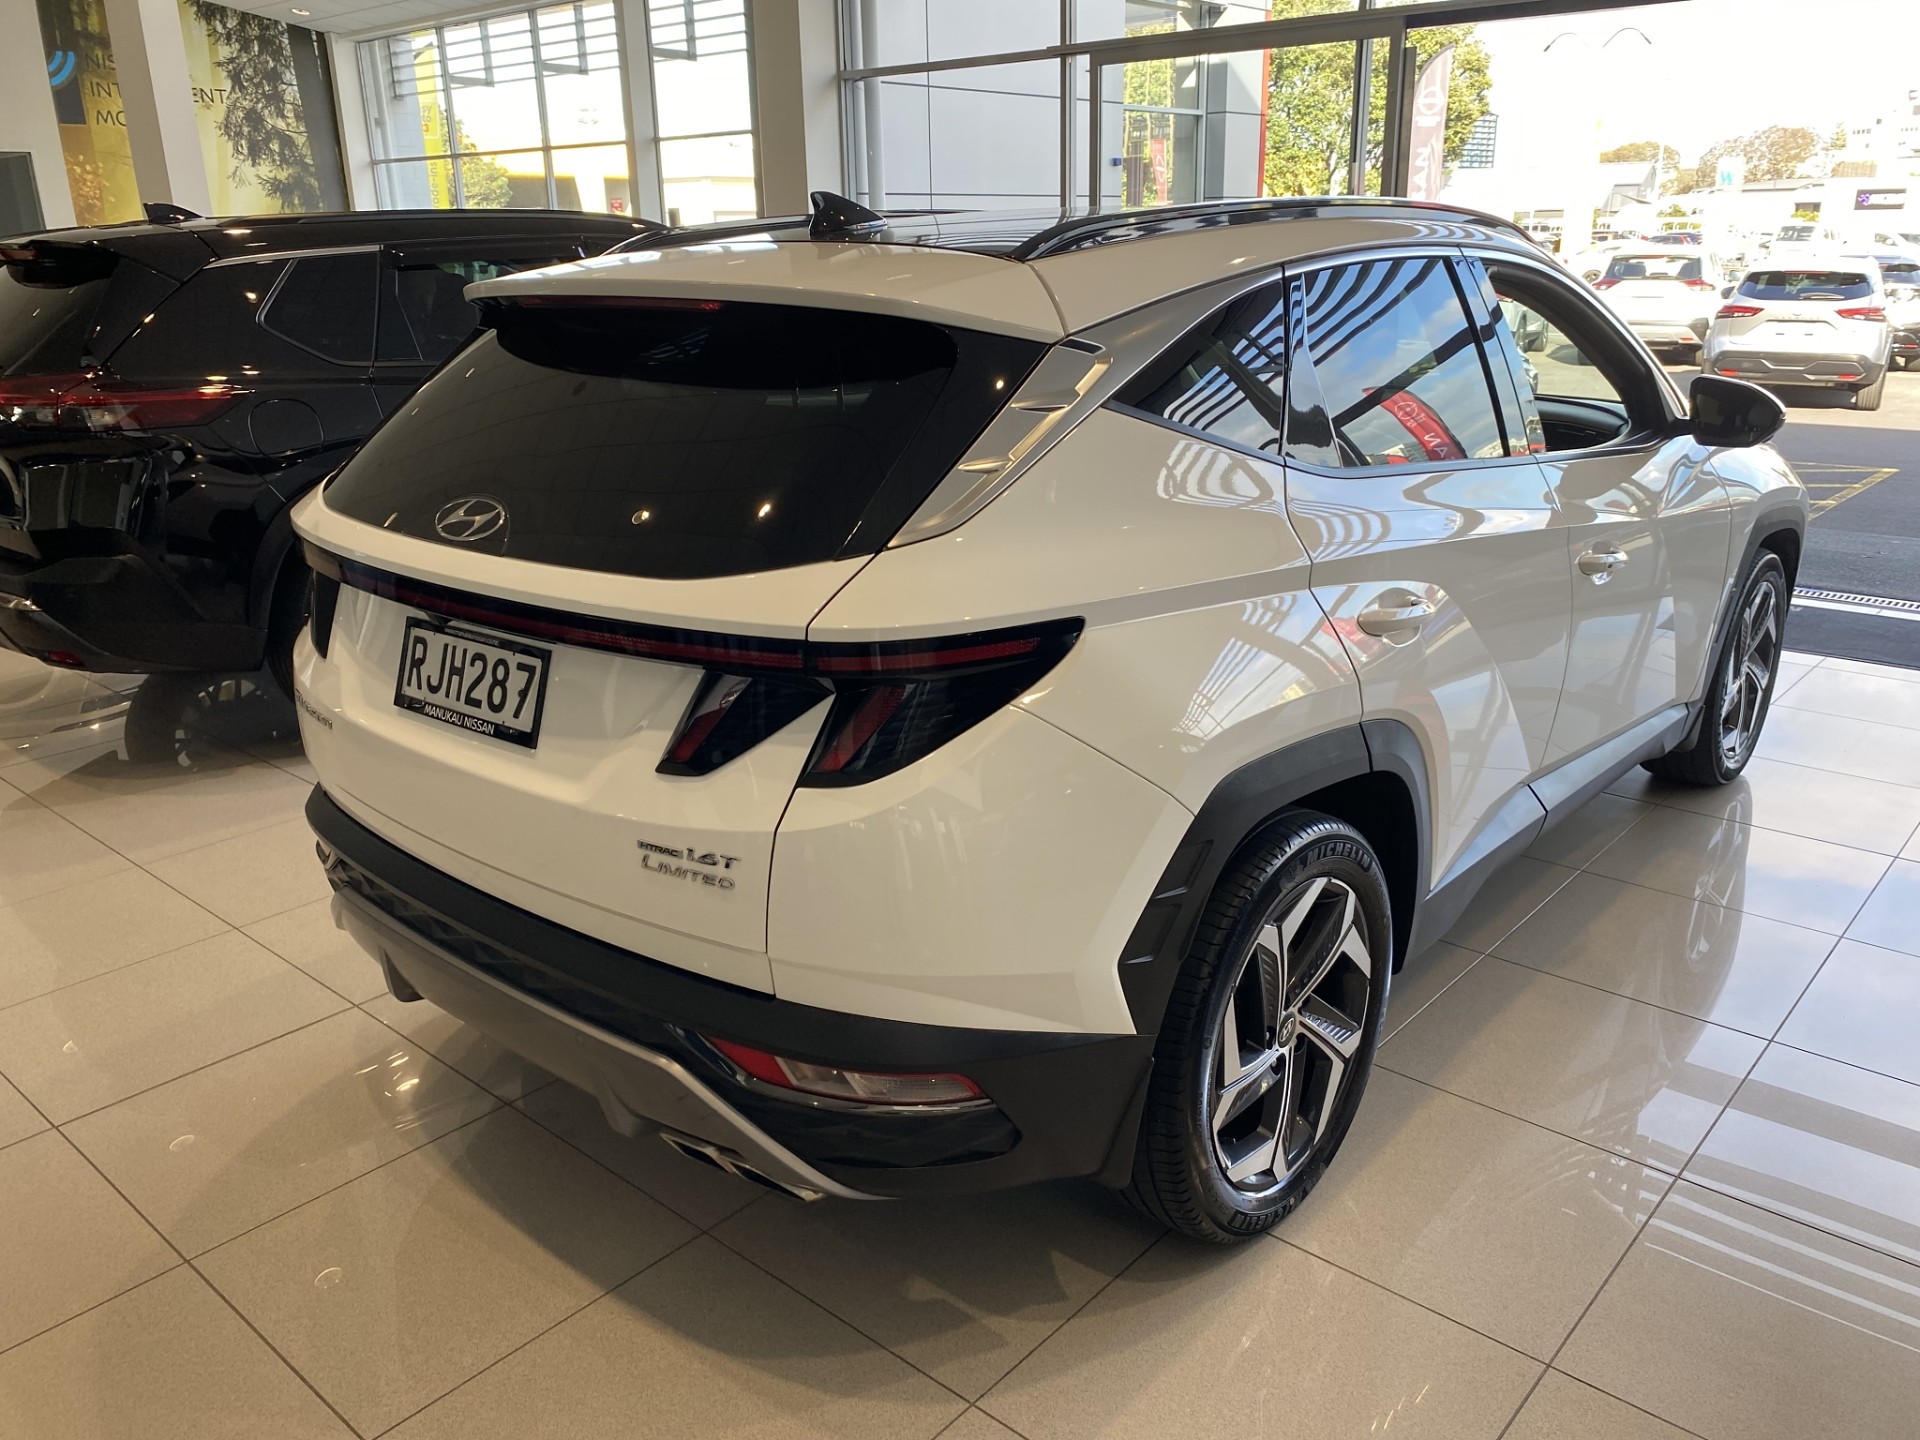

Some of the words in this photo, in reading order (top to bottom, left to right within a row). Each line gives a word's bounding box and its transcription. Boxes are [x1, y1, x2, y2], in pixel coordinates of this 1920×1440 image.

[406, 634, 538, 720] RJH287
[424, 703, 464, 726] MANUKAU
[463, 716, 495, 735] NISSAN
[637, 840, 683, 860] HTRAC
[1307, 842, 1371, 869] MICHELIN
[642, 852, 735, 890] LIMITED
